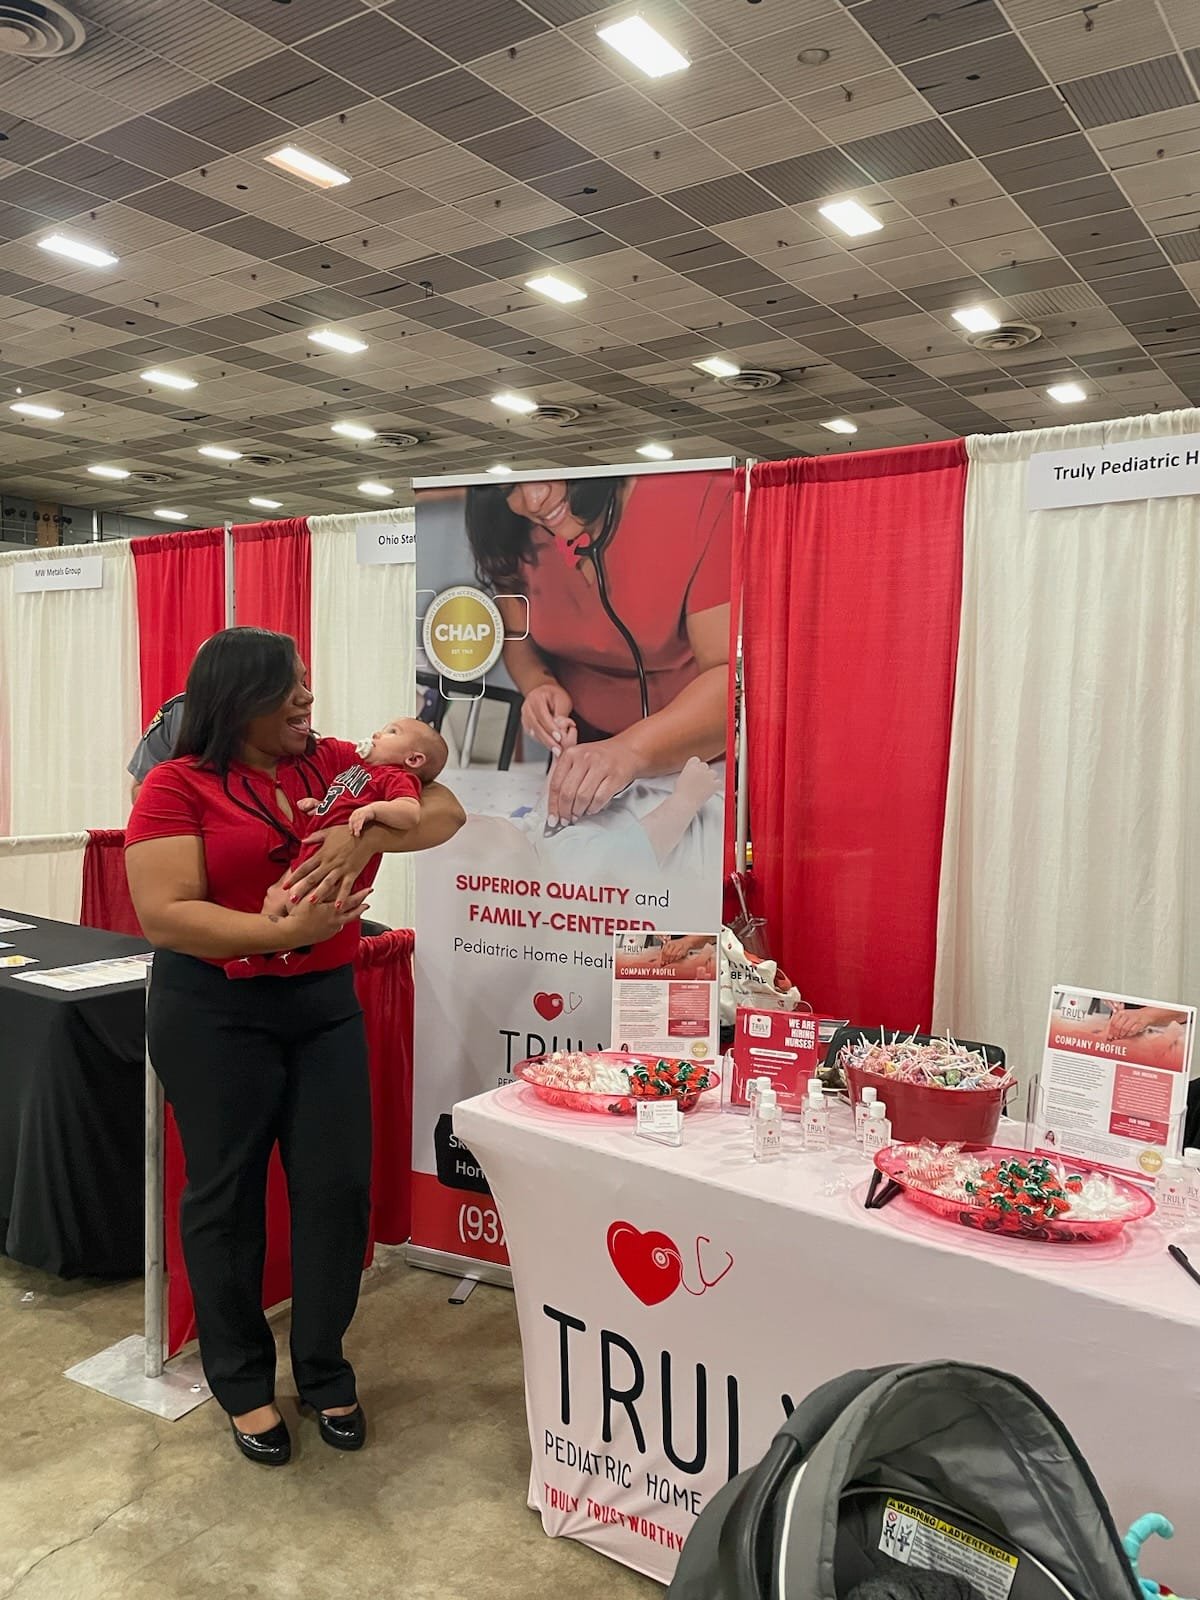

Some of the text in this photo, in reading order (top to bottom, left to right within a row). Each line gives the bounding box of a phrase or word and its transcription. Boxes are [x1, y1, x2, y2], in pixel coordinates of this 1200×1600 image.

[1054, 463, 1096, 480] Truly
[1100, 453, 1180, 475] Pediatric
[378, 534, 399, 546] Ohio
[46, 568, 64, 576] Metals
[64, 567, 81, 576] Group
[434, 624, 491, 642] CHAP
[456, 874, 670, 908] SUPERIOR QUALITY and
[454, 937, 518, 958] Pediatric
[523, 946, 568, 964] Home
[623, 944, 644, 953] TRULY
[620, 968, 676, 976] COMPANY PROFILE
[1061, 1006, 1088, 1018] TRULY
[788, 1018, 816, 1030] WE ARE
[791, 1028, 815, 1040] HIRING
[784, 1038, 814, 1050] NURSES!
[1054, 1034, 1128, 1056] COMPANY PROFILE
[807, 1124, 826, 1132] TRULY
[762, 1136, 780, 1144] TRULY
[1162, 1194, 1186, 1204] TRULY
[459, 1204, 504, 1246] (93
[543, 1304, 796, 1482] TRUL
[544, 1429, 703, 1516] PEDIATRIC HOME
[544, 1482, 684, 1552] TRULY TRUSTWORTHY
[896, 1500, 1010, 1564] WARNING ADVERTENCIA
